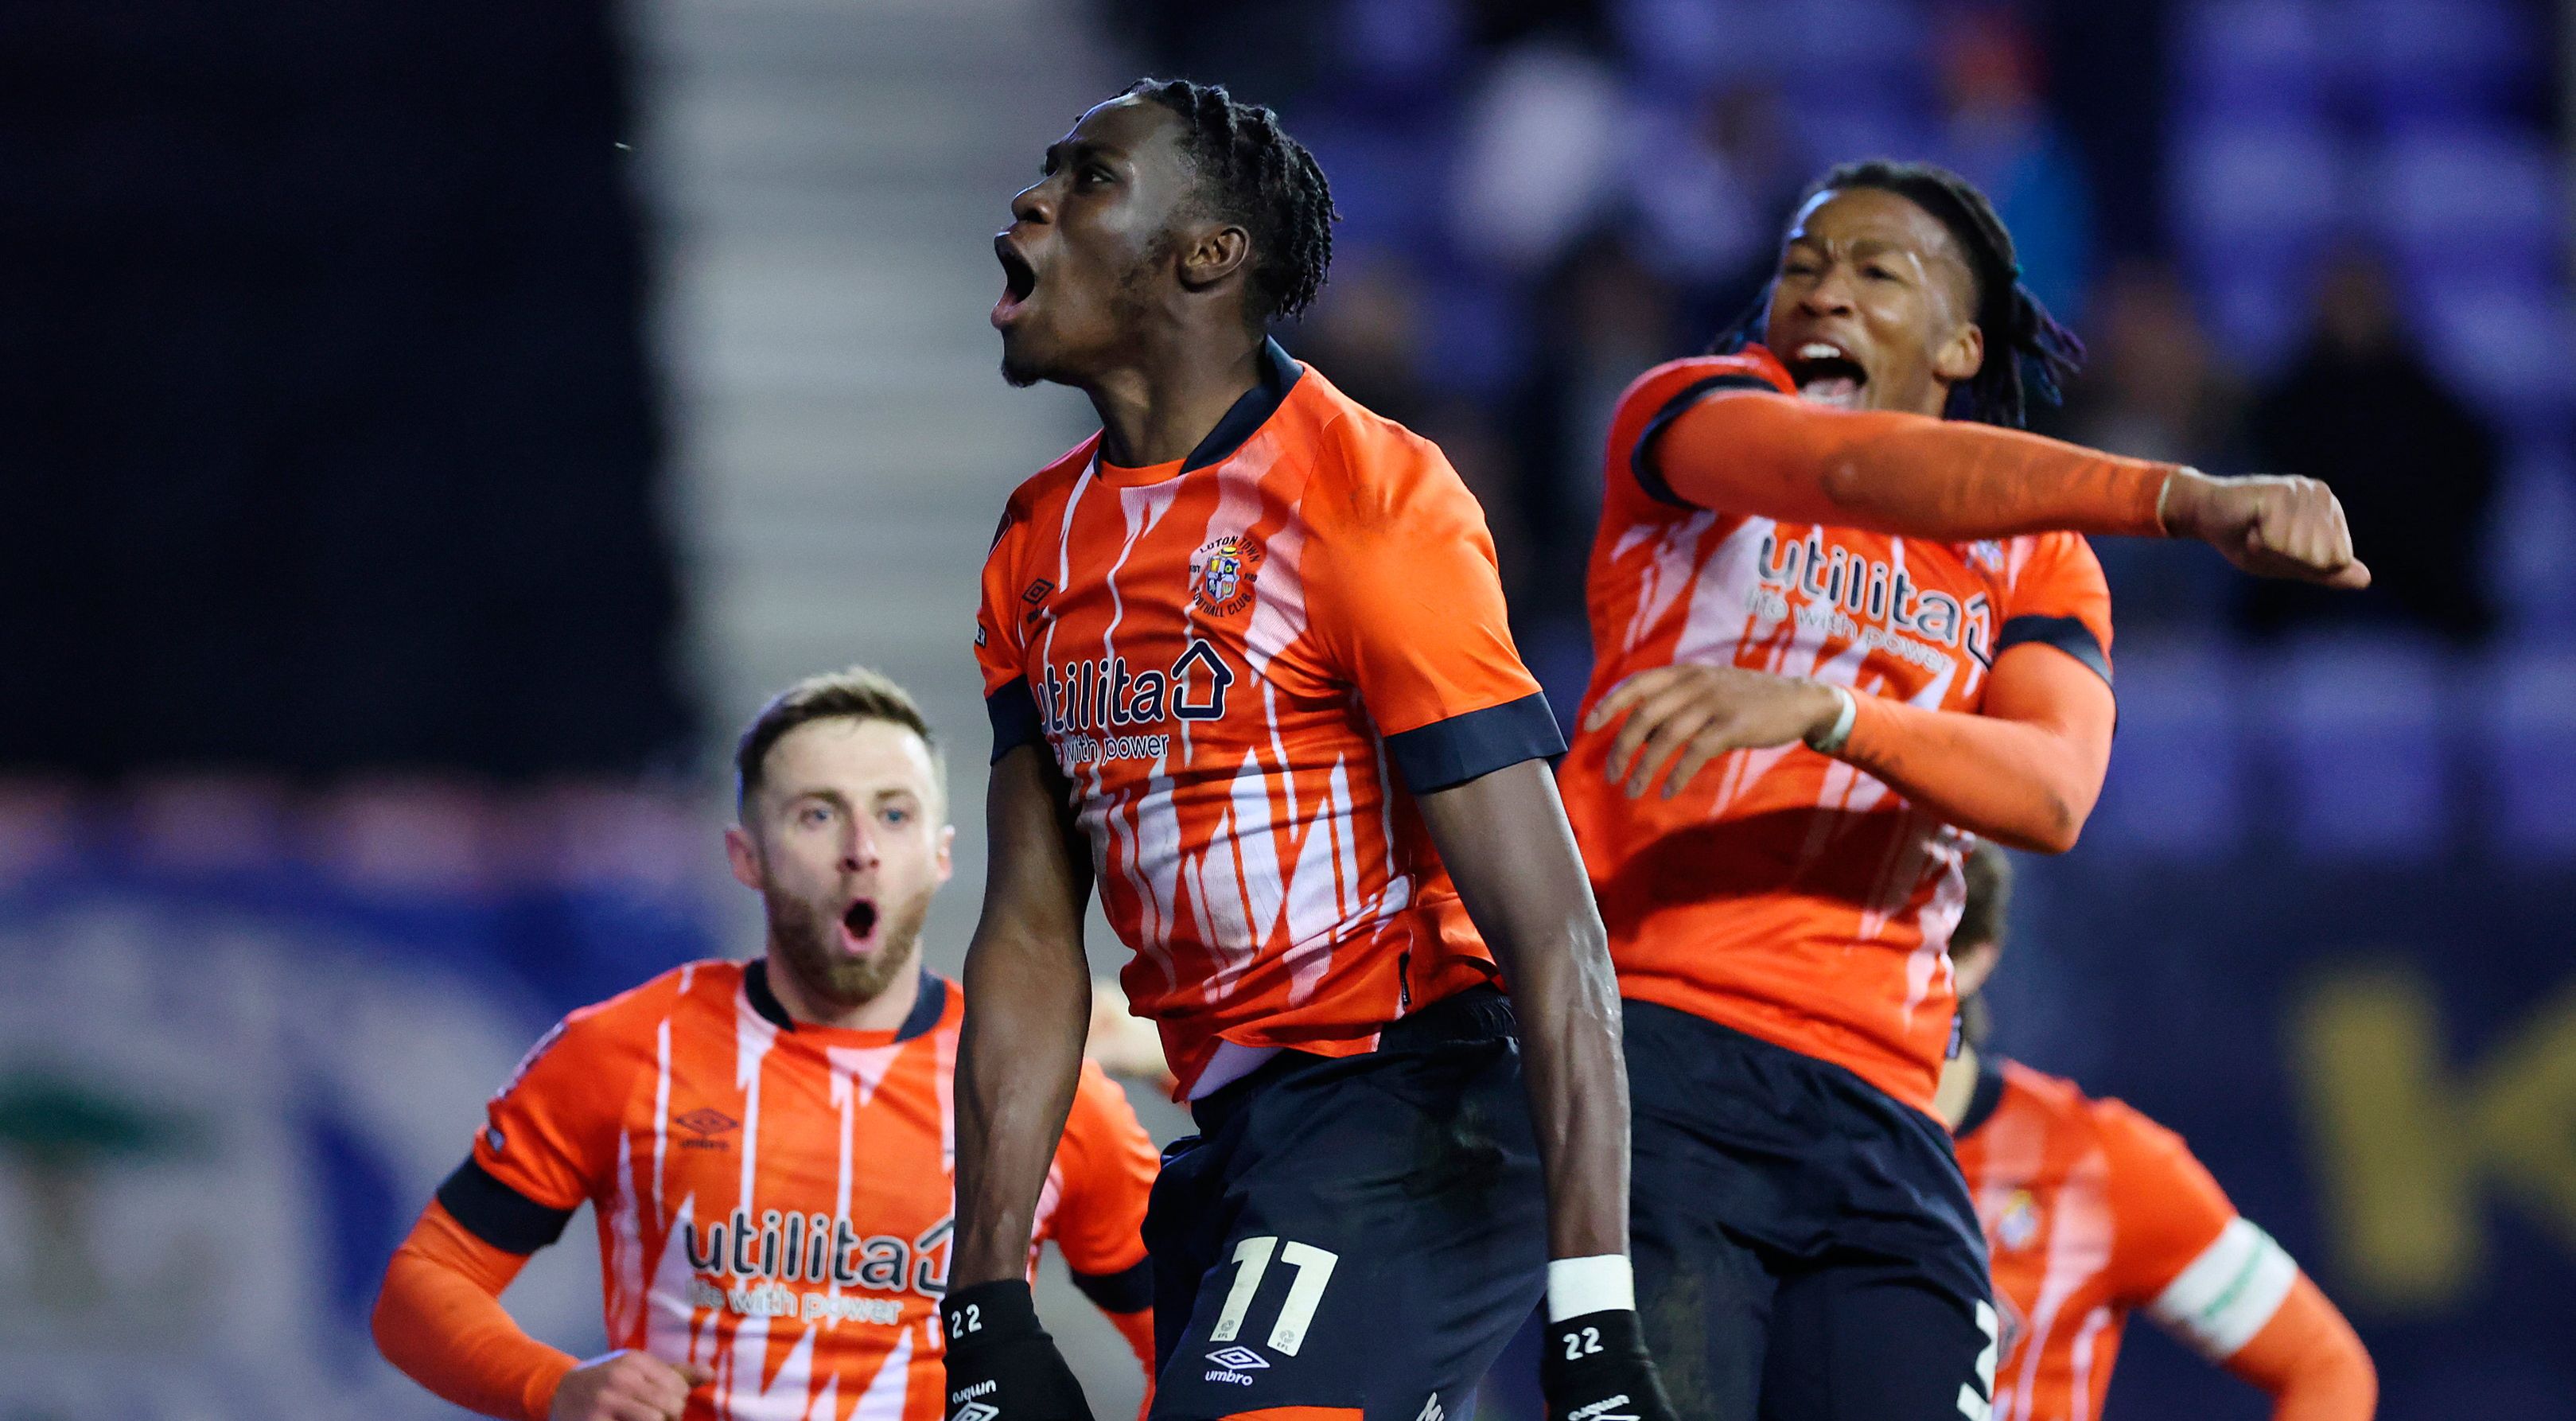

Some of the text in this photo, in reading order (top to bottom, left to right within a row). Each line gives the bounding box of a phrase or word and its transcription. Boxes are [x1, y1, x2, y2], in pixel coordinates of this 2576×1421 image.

[1200, 535, 1260, 563] LUTON TOWN
[1193, 586, 1251, 617] FOOTBALL CLUB
[1757, 533, 1958, 645] utilita
[1062, 733, 1099, 763] with
[1102, 734, 1169, 766] power
[683, 1209, 909, 1291] utilita
[1209, 1236, 1339, 1357] 11
[951, 1304, 982, 1339] 22
[1277, 1342, 1288, 1351] EFL
[1563, 1327, 1604, 1361] 22
[952, 1380, 996, 1404] umbro
[1205, 1369, 1253, 1386] umbro
